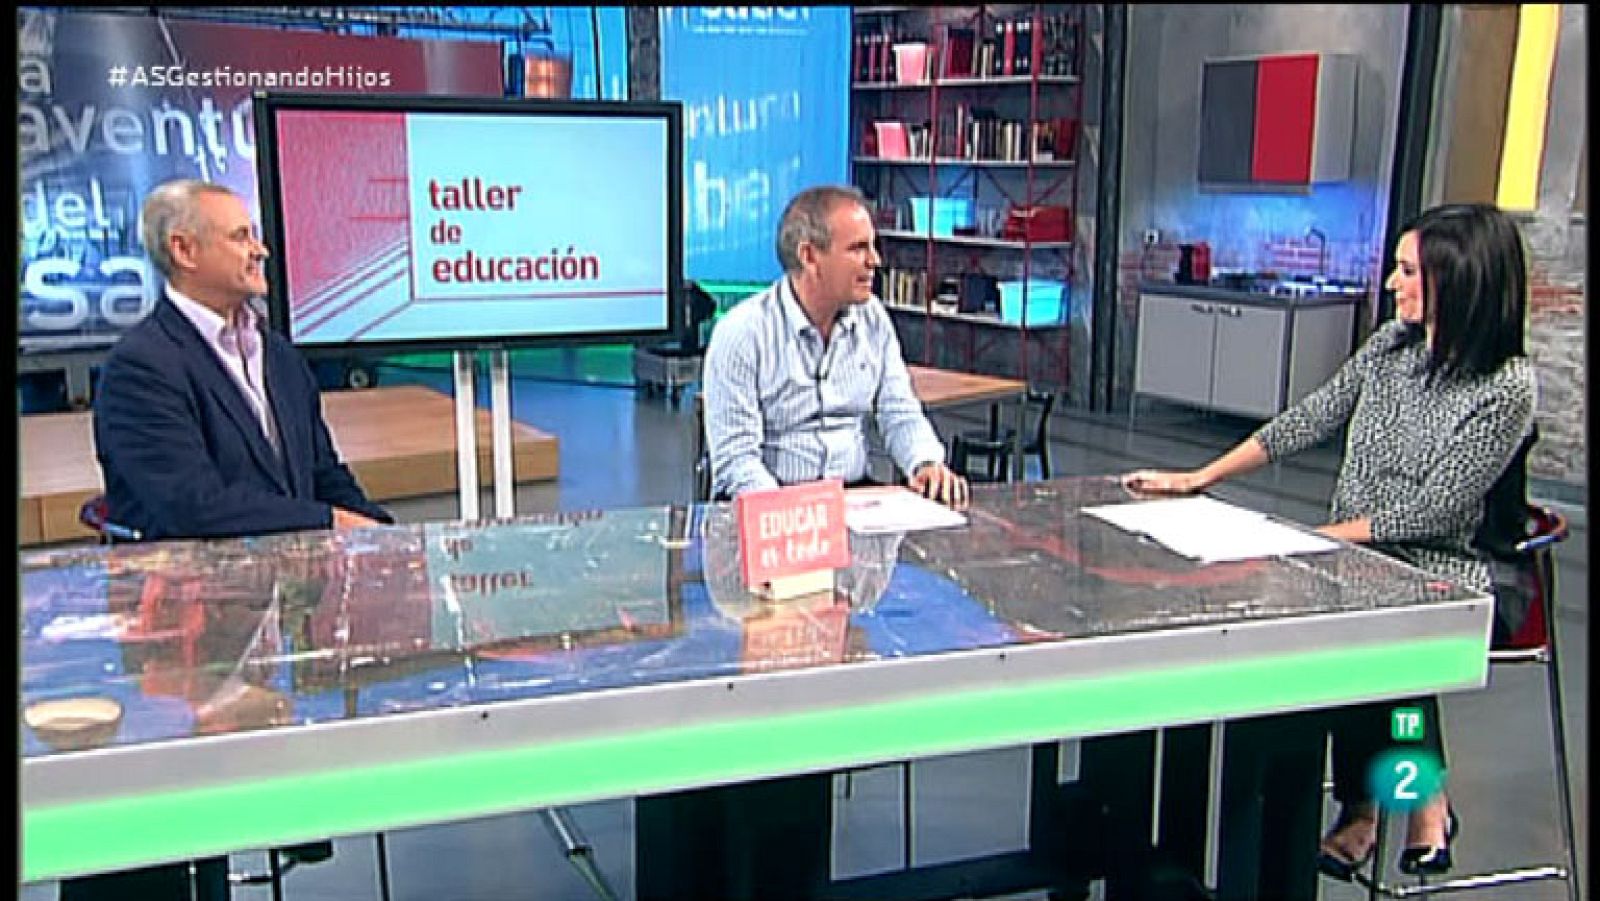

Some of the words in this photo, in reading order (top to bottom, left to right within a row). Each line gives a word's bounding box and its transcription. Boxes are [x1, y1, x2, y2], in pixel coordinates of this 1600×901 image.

[429, 177, 522, 211] taller
[430, 218, 462, 244] de
[432, 244, 600, 283] educación
[760, 503, 829, 540] EDUCAR
